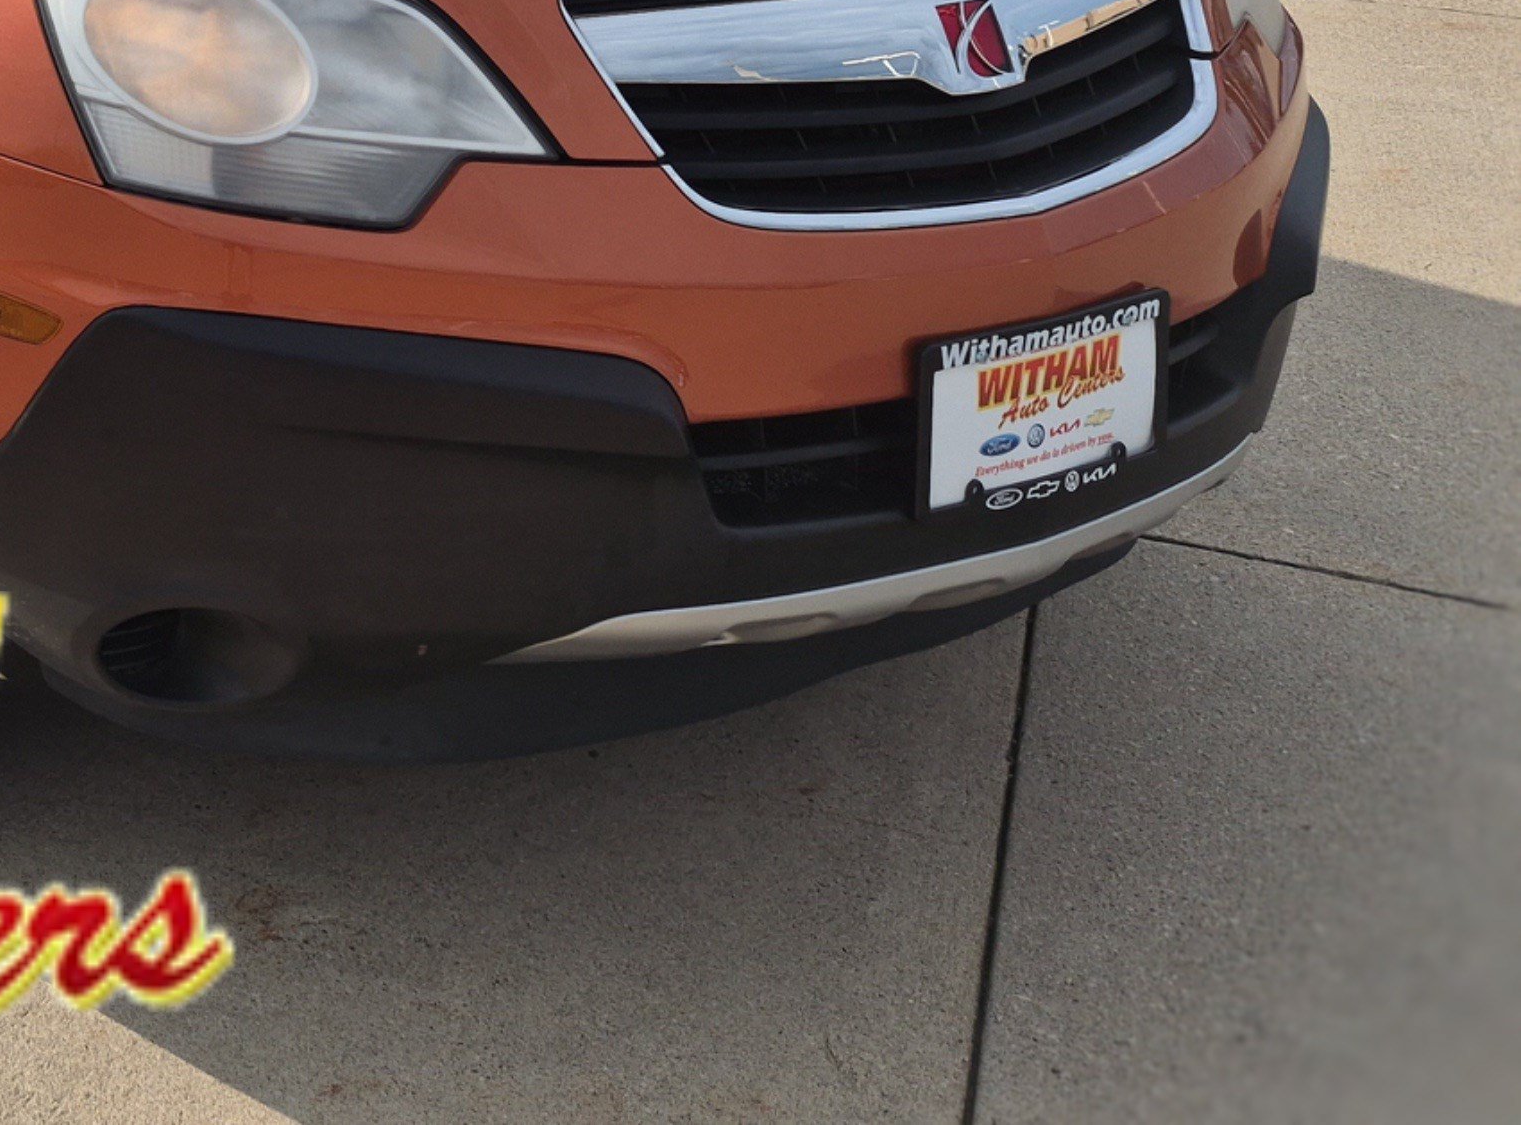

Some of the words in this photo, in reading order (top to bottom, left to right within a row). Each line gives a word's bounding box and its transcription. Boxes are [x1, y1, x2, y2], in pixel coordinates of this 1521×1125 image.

[940, 298, 1161, 371] Withamauto.com
[978, 334, 1121, 409] WITHAM
[998, 394, 1050, 429] Auto
[1057, 365, 1126, 409] Centers
[974, 458, 1026, 478] Everything
[1060, 440, 1087, 458] driven
